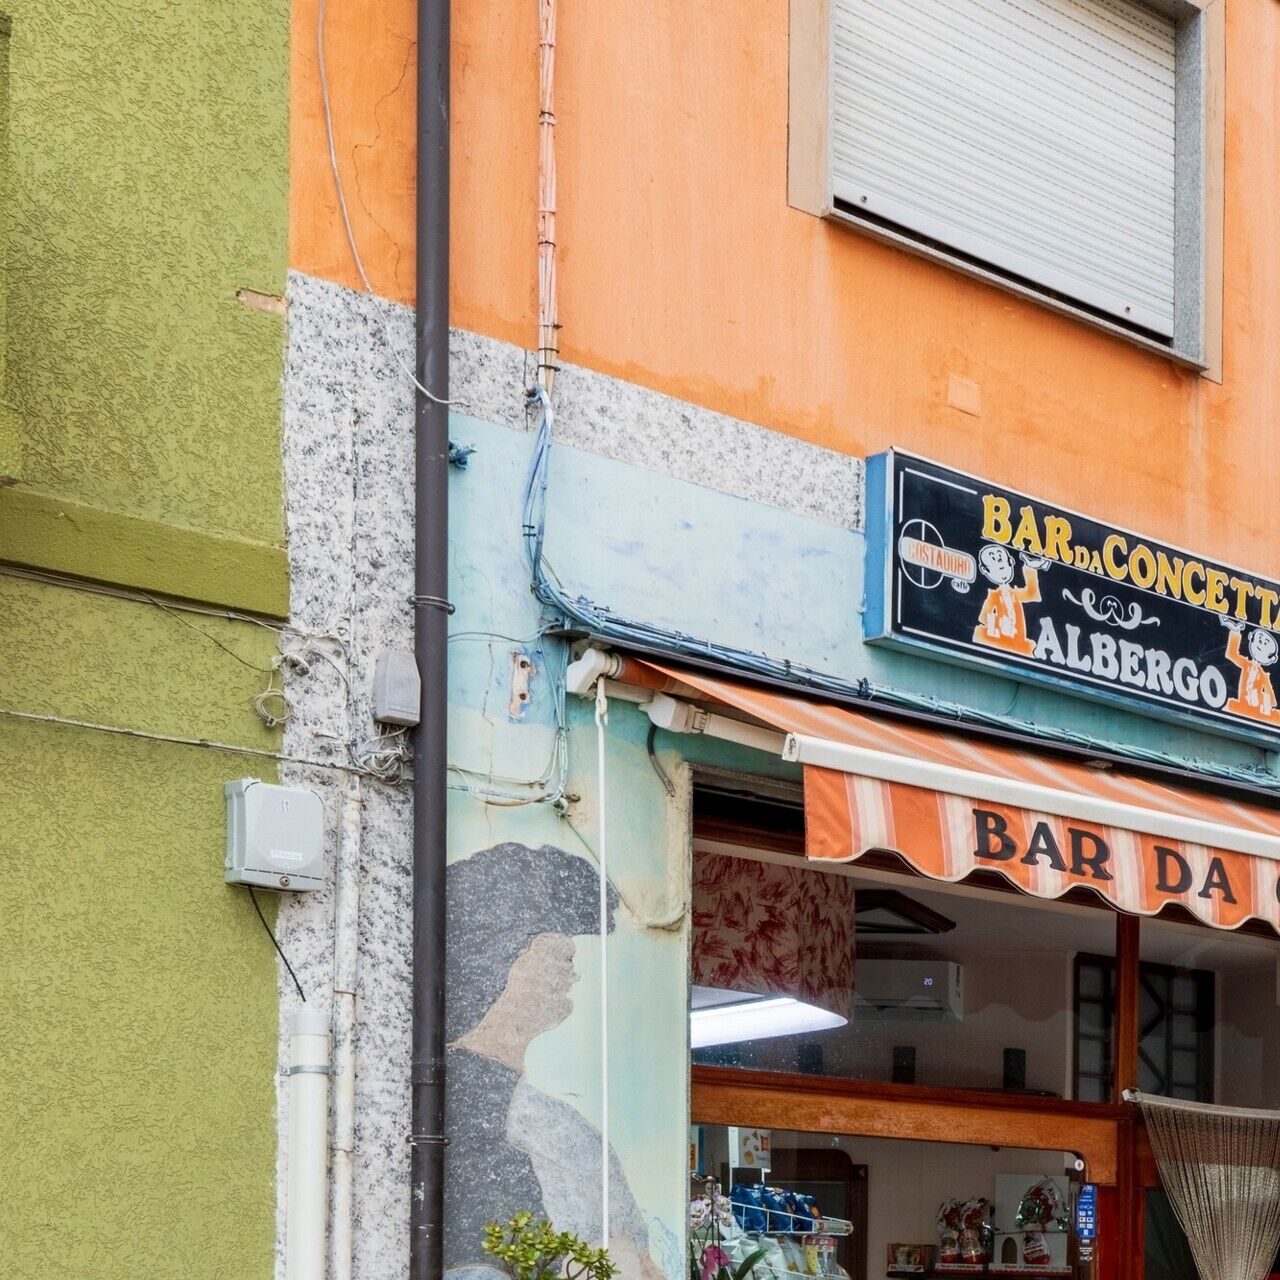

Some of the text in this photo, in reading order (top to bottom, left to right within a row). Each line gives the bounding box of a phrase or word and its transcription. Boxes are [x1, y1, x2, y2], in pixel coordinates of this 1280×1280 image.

[981, 494, 1074, 565] BAR
[1075, 545, 1105, 576] DA
[1034, 616, 1227, 710] ALBERGO
[972, 808, 1113, 880] BAR
[1154, 845, 1237, 904] DA
